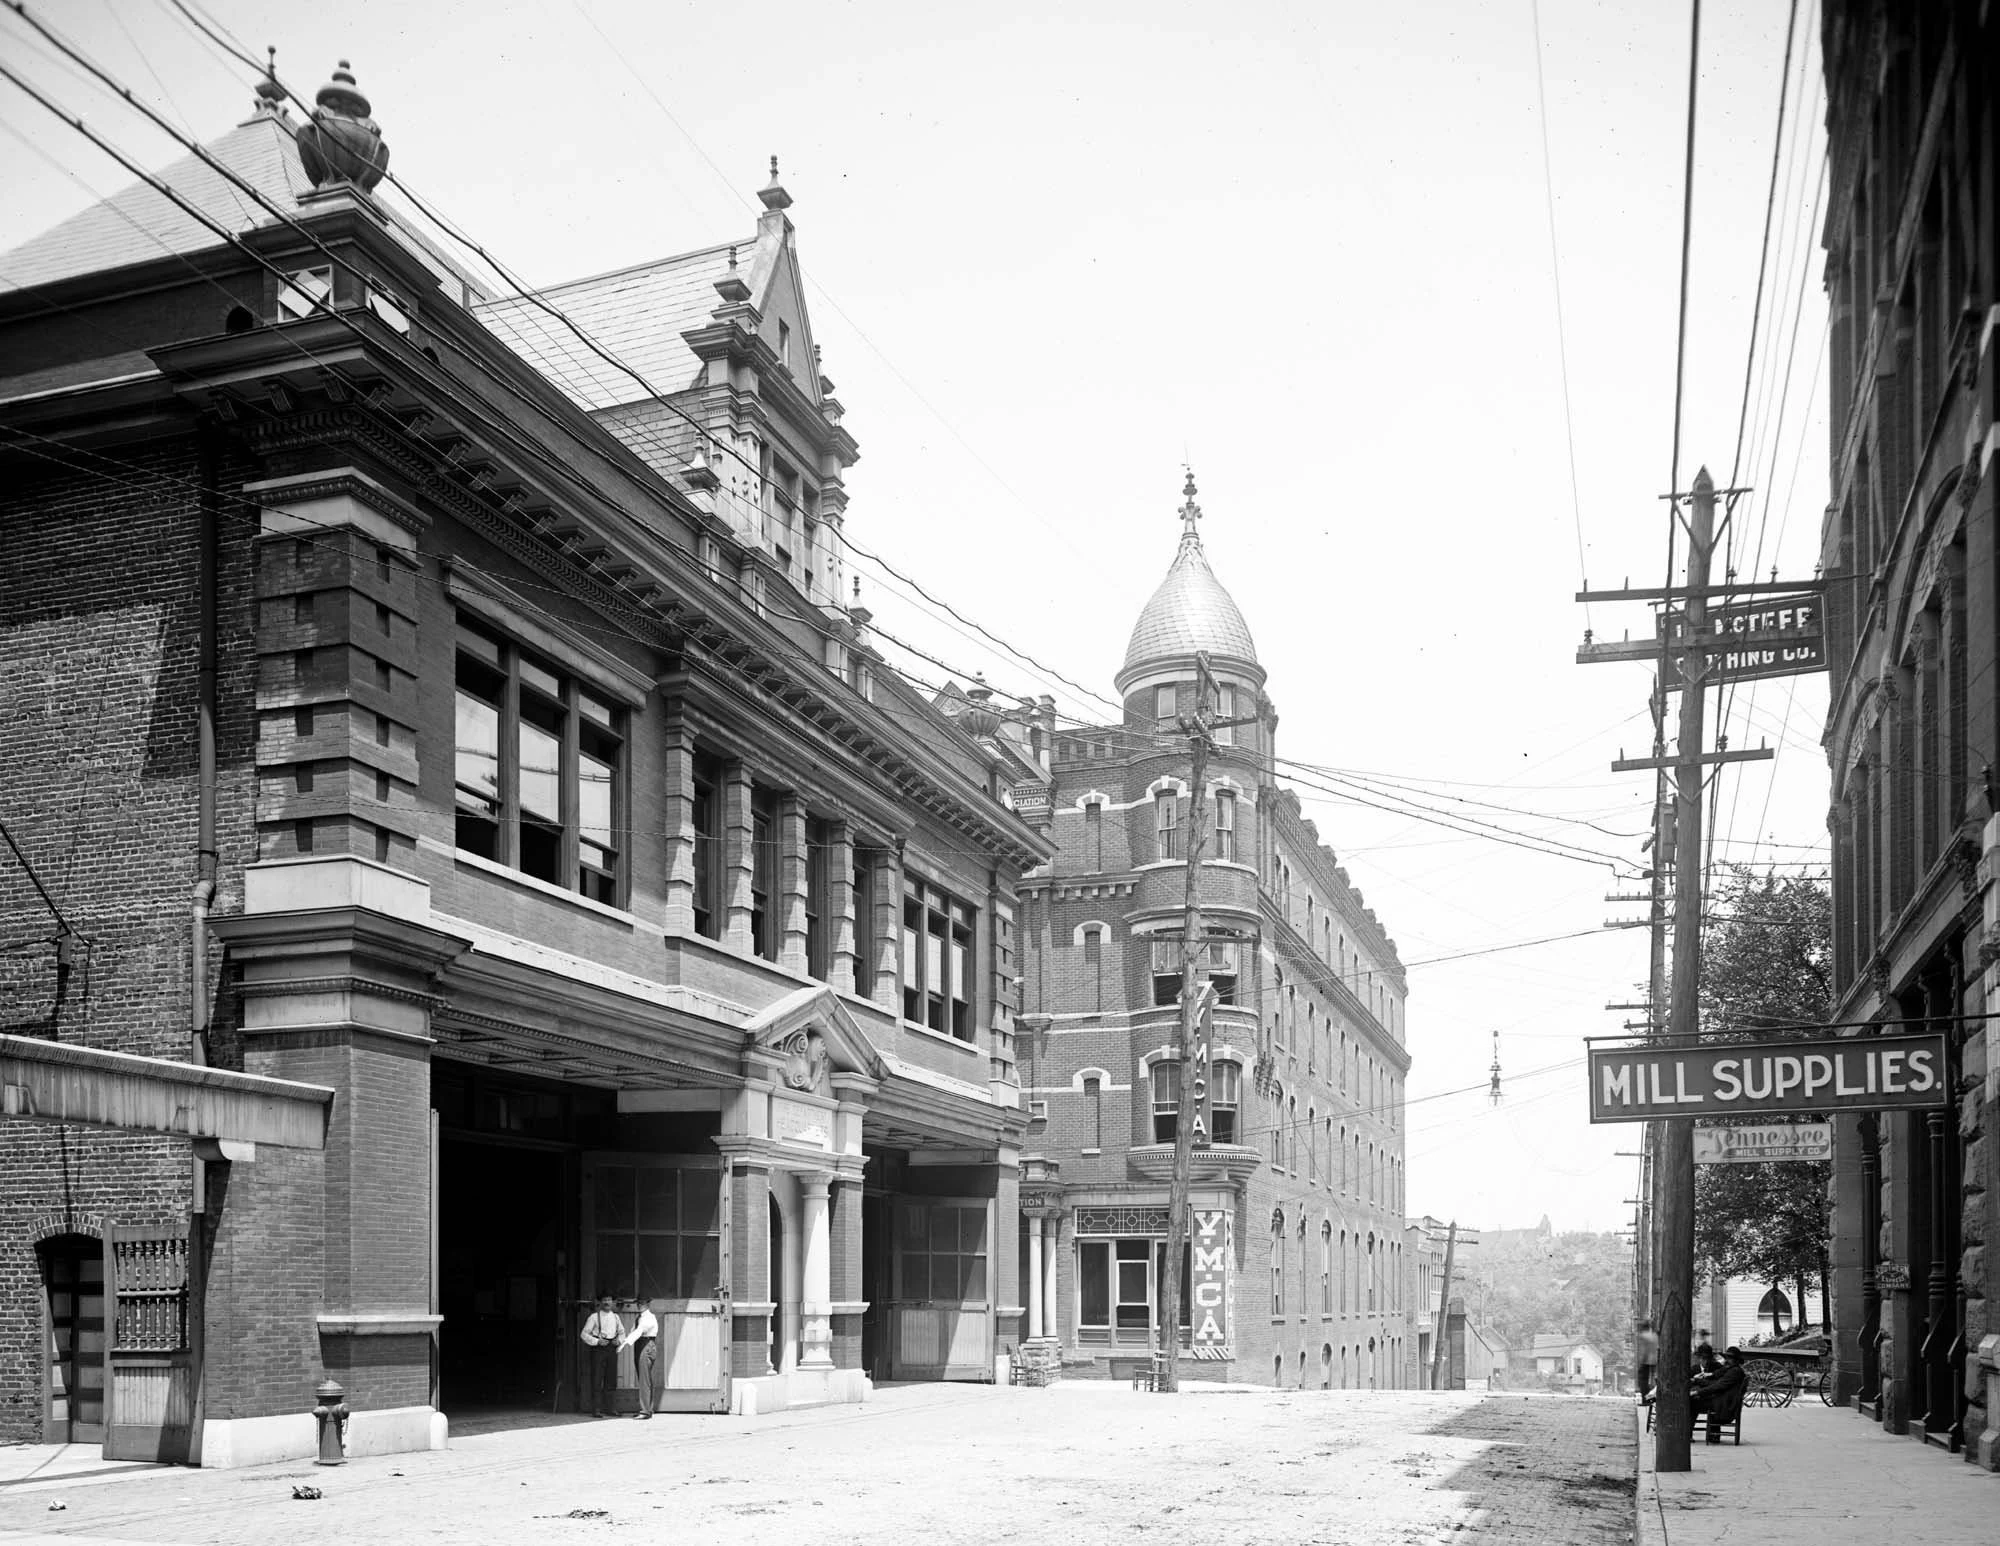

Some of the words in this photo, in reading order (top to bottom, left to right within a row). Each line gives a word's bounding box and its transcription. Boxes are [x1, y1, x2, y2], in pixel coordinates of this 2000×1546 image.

[1603, 1062, 1704, 1106] MILL
[1712, 1050, 1943, 1101] SUPPLIES.
[1735, 1147, 1760, 1157] MILL
[1764, 1147, 1805, 1156] SUPPLY
